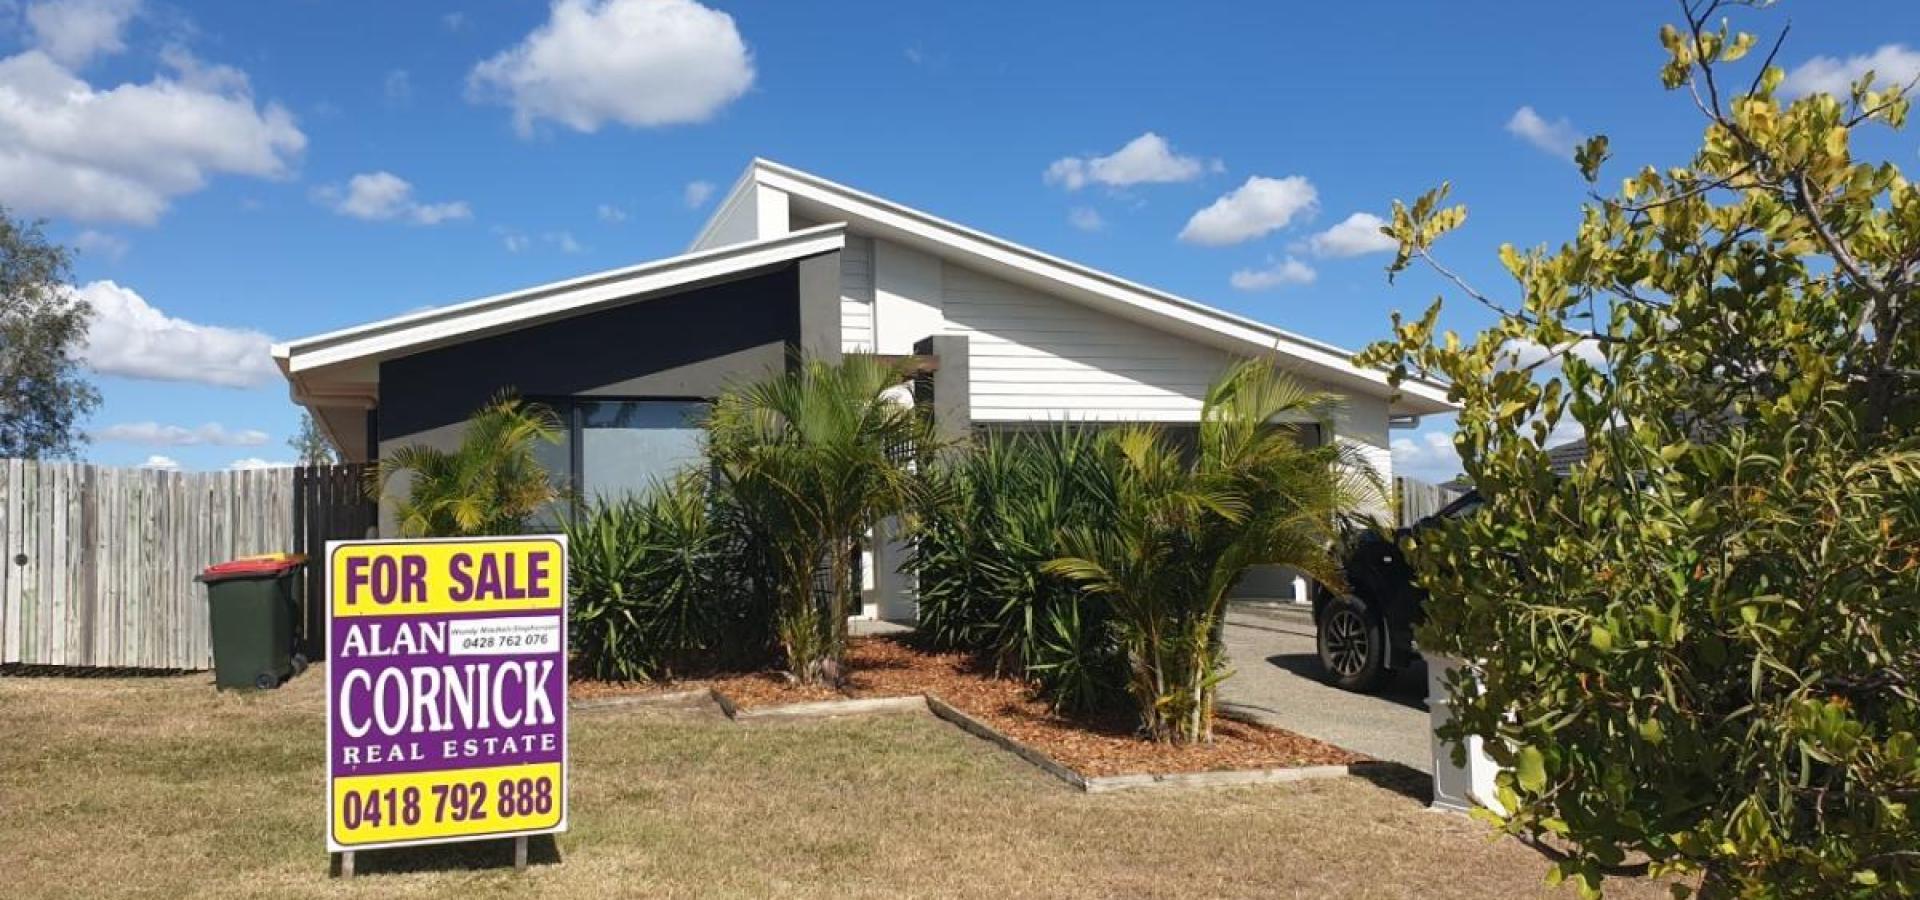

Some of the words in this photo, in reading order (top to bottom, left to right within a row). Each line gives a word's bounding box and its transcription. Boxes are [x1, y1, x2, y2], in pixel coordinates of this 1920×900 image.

[346, 554, 427, 605] FOR
[449, 552, 550, 602] SALE
[341, 621, 447, 657] ALAN
[463, 637, 494, 649] 0428
[499, 635, 522, 647] 762
[525, 634, 548, 645] 076
[340, 659, 556, 737] CORNICK
[343, 743, 425, 764] REAL
[443, 734, 556, 759] ESTATE
[343, 786, 421, 830] 0418
[431, 781, 487, 823] 792
[498, 776, 552, 817] 888
